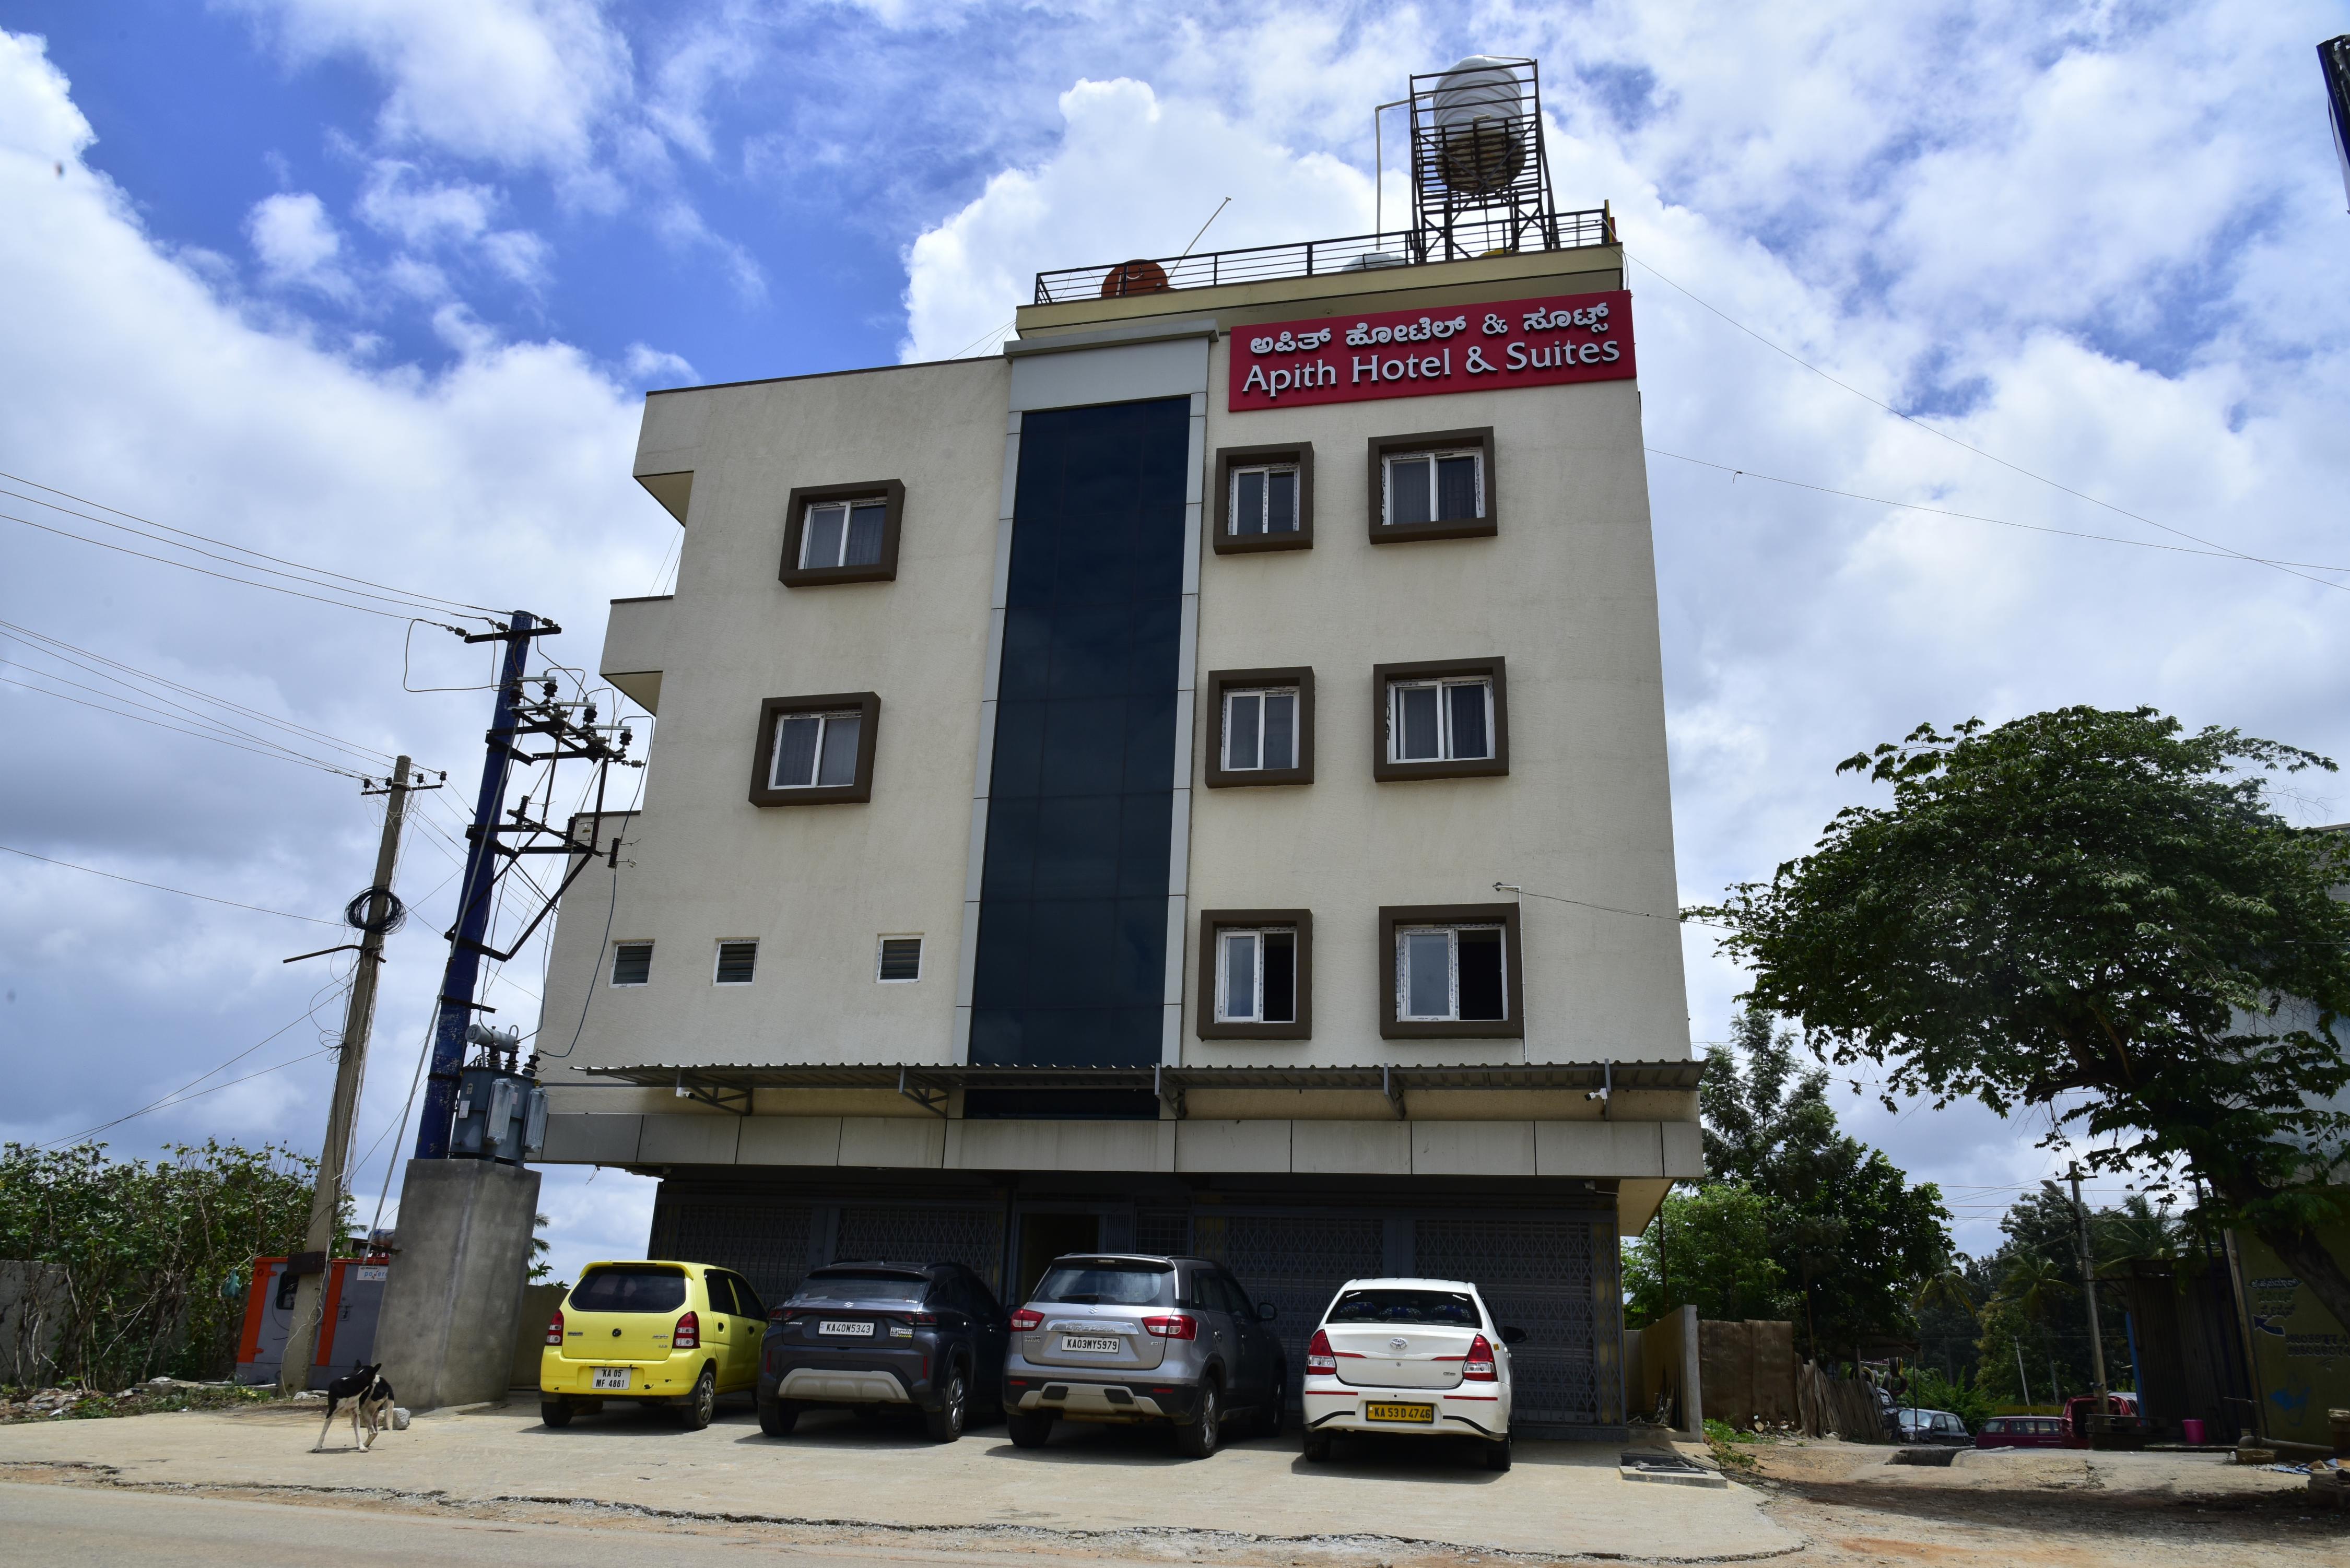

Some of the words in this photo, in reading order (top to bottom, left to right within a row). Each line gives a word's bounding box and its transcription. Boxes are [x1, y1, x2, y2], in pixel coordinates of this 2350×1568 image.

[1251, 328, 1331, 353] ಅಪಿತ್
[1346, 316, 1466, 346] ಹೋಟೆಲ್
[1483, 314, 1508, 335] &
[1523, 302, 1609, 333] ಸೂಟ್ಸ್
[1242, 359, 1337, 397] Apith
[1352, 348, 1451, 383] Hotel
[1466, 346, 1498, 373] &
[1506, 340, 1620, 370] Suites
[826, 1323, 871, 1334] KA40N5343
[1067, 1338, 1117, 1350] KA03MY5979
[603, 1369, 611, 1377] KA
[614, 1369, 622, 1377] 05
[1374, 1407, 1385, 1417] KA
[1388, 1408, 1399, 1418] 53
[1401, 1408, 1406, 1418] D
[1408, 1408, 1431, 1419] 4746
